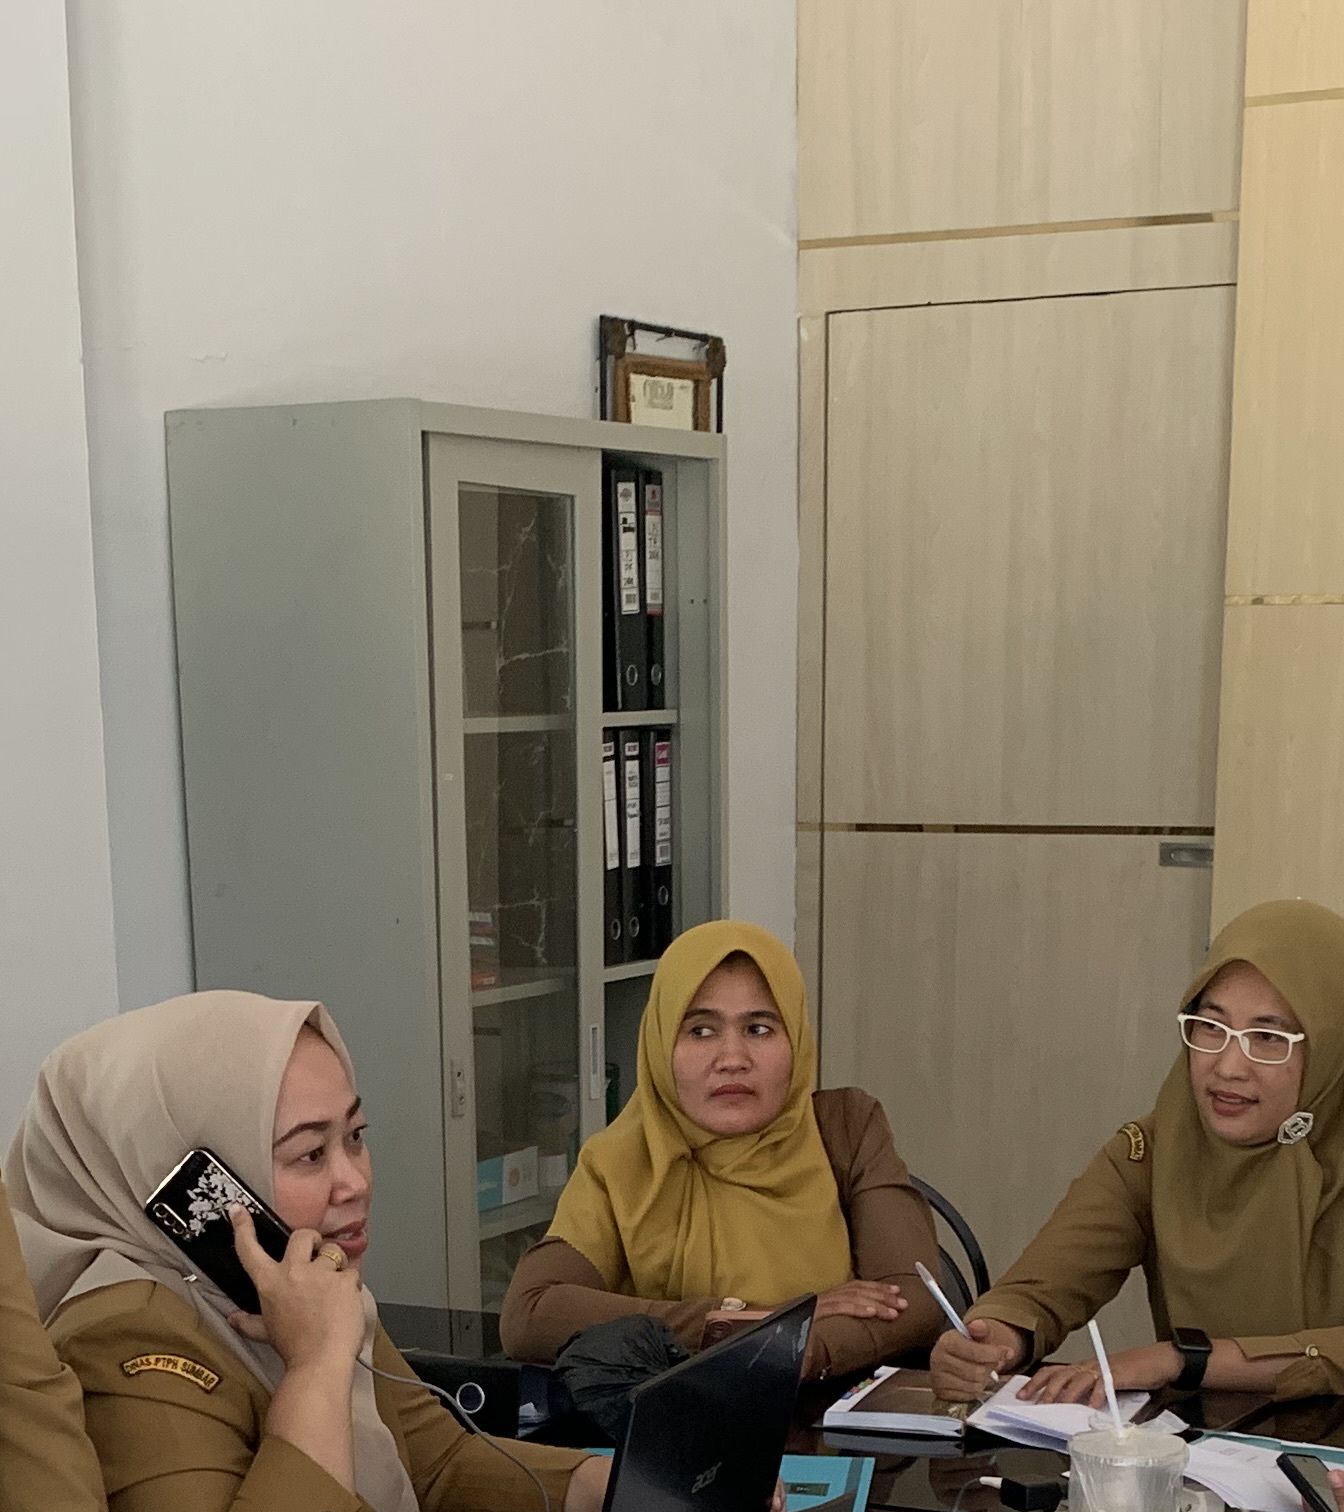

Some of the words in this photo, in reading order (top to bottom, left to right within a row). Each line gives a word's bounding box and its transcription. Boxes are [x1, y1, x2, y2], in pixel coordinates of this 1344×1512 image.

[154, 1357, 179, 1370] PTPH
[181, 1361, 216, 1387] SUMBAR
[691, 1461, 722, 1494] acer
